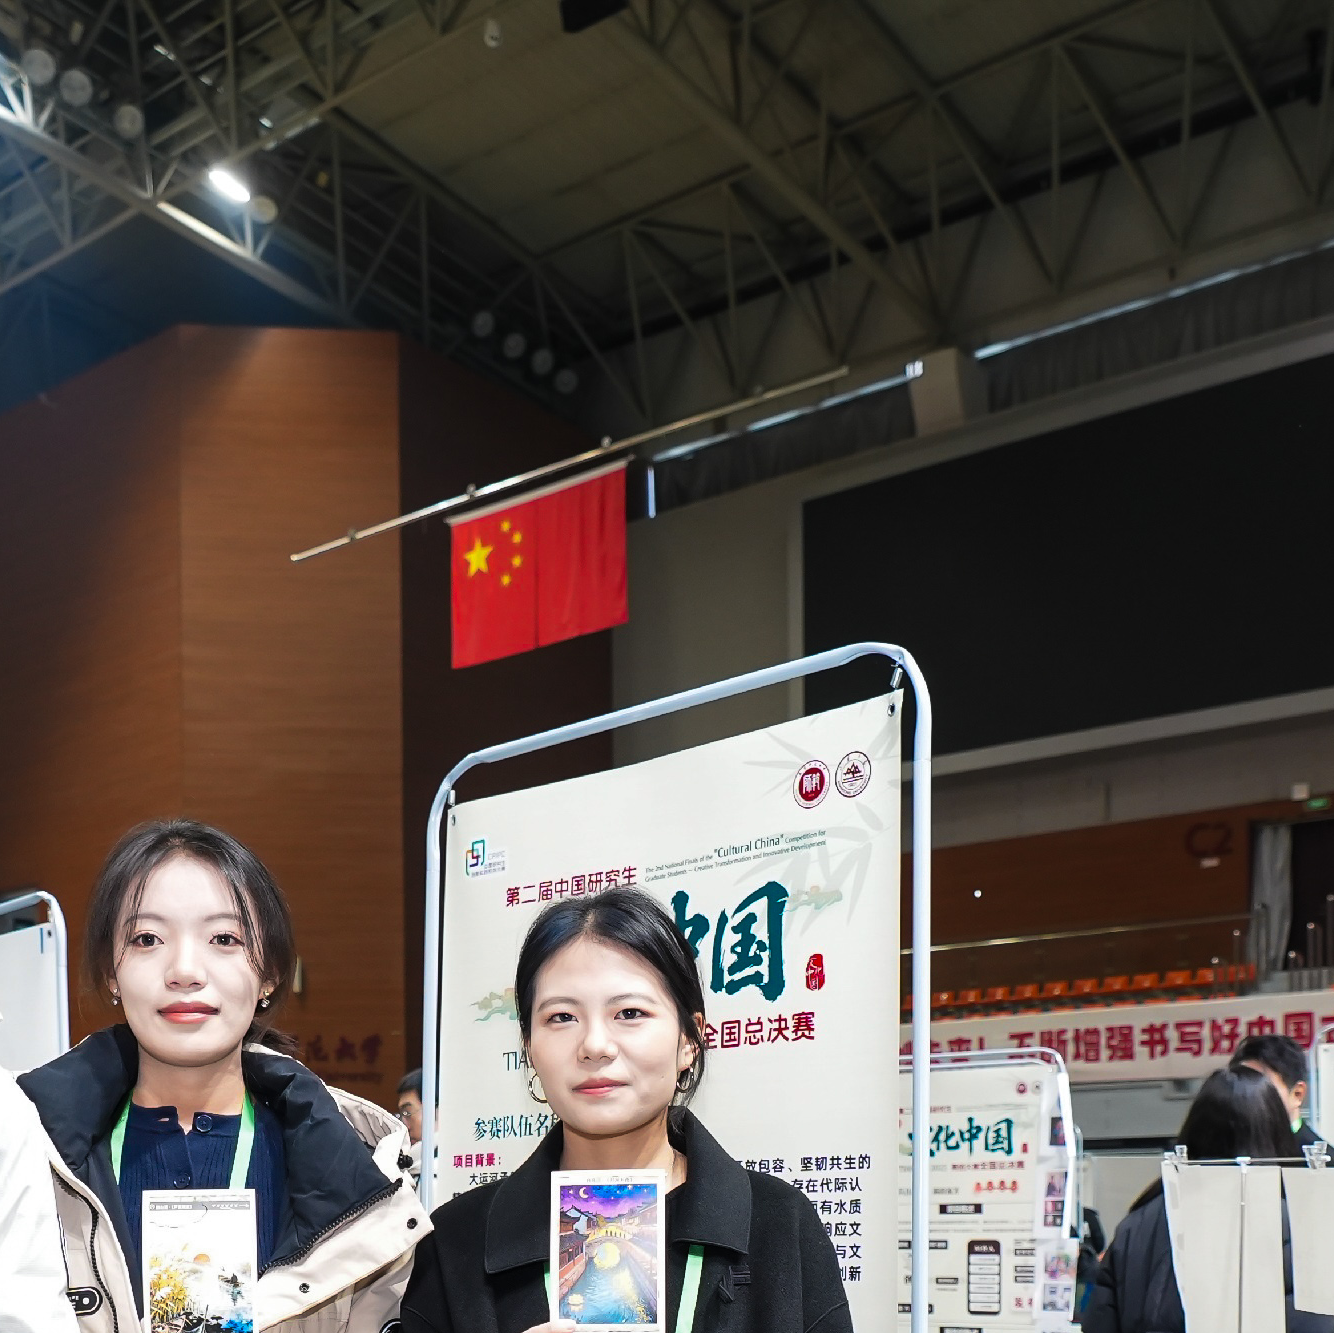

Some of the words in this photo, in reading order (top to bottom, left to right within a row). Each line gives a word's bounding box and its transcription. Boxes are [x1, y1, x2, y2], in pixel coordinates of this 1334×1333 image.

[785, 832, 817, 845] Competition
[715, 856, 752, 868] Transformation
[763, 847, 789, 859] Innovative
[790, 840, 826, 853] Development
[505, 866, 638, 907] 第二届中国研究生
[704, 1011, 815, 1050] 全国总决赛
[907, 1116, 1014, 1158] 化中国
[453, 1153, 501, 1168] 项目背景：
[791, 1177, 862, 1194] 存在代际认
